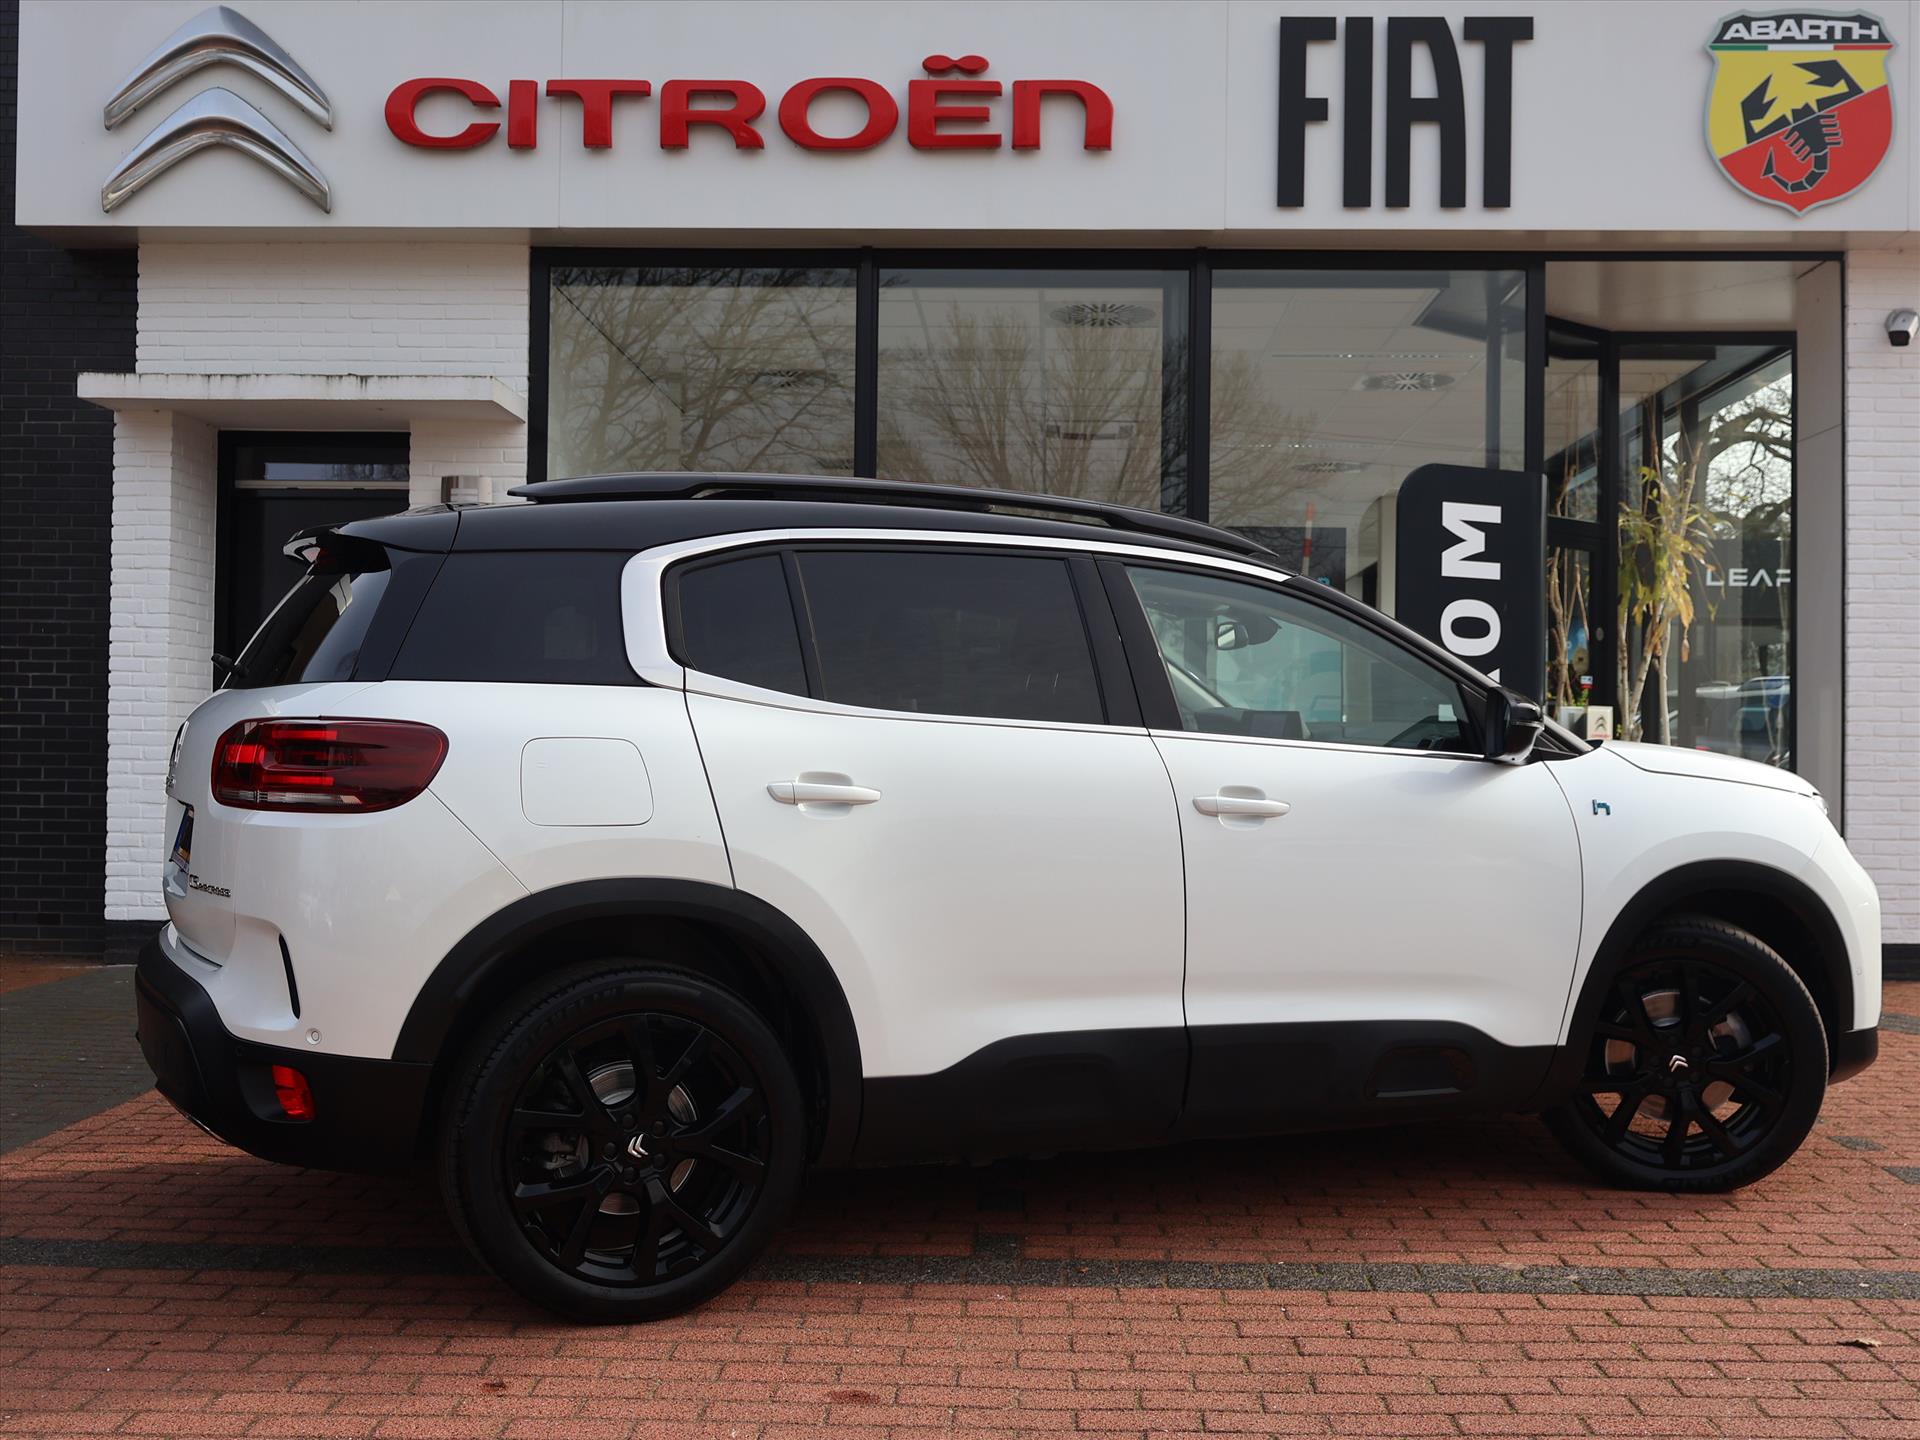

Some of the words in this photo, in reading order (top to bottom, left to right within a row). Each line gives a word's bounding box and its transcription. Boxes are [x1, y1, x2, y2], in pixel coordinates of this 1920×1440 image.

[1722, 18, 1880, 41] ABARTH
[385, 55, 1115, 150] CITROËN
[1277, 16, 1534, 208] FIAT
[1440, 501, 1502, 684] OM
